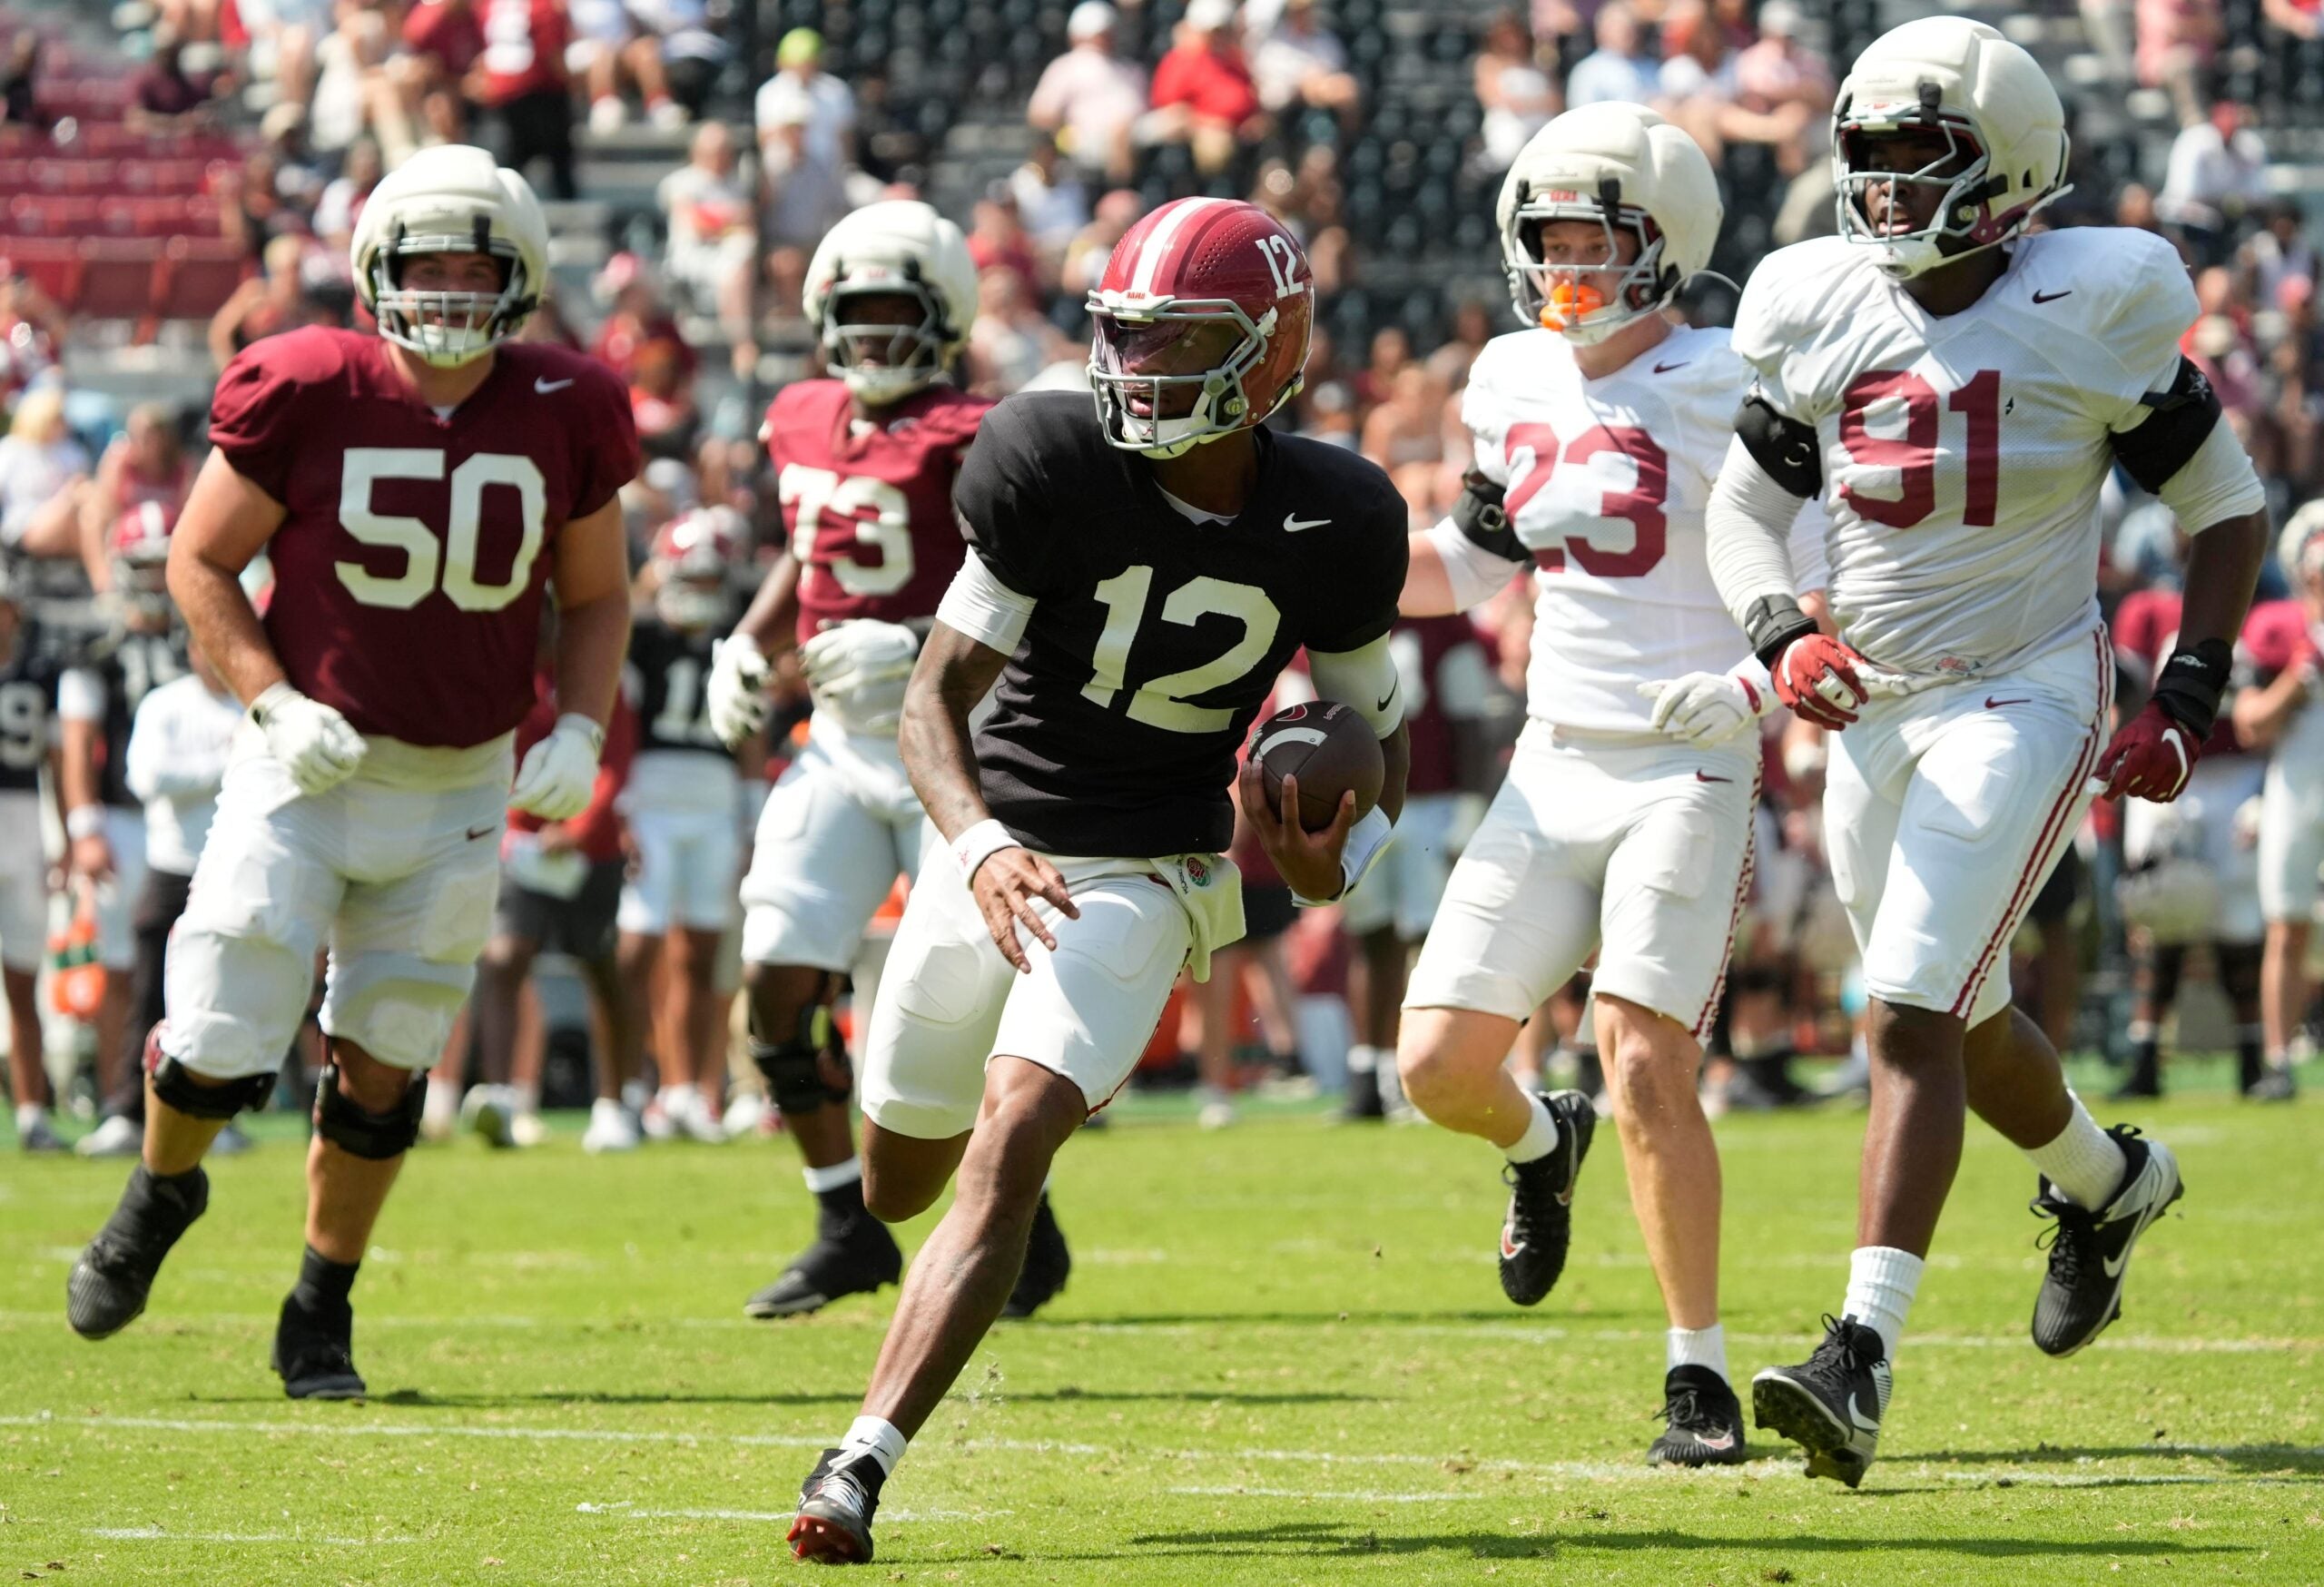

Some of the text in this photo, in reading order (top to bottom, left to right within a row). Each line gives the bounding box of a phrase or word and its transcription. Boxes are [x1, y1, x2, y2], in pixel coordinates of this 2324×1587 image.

[1255, 234, 1305, 299] 12
[1502, 421, 1668, 577] 23
[1839, 369, 2001, 529] 91
[334, 447, 547, 612] 50
[779, 462, 915, 597] 73
[1078, 565, 1281, 734] 12
